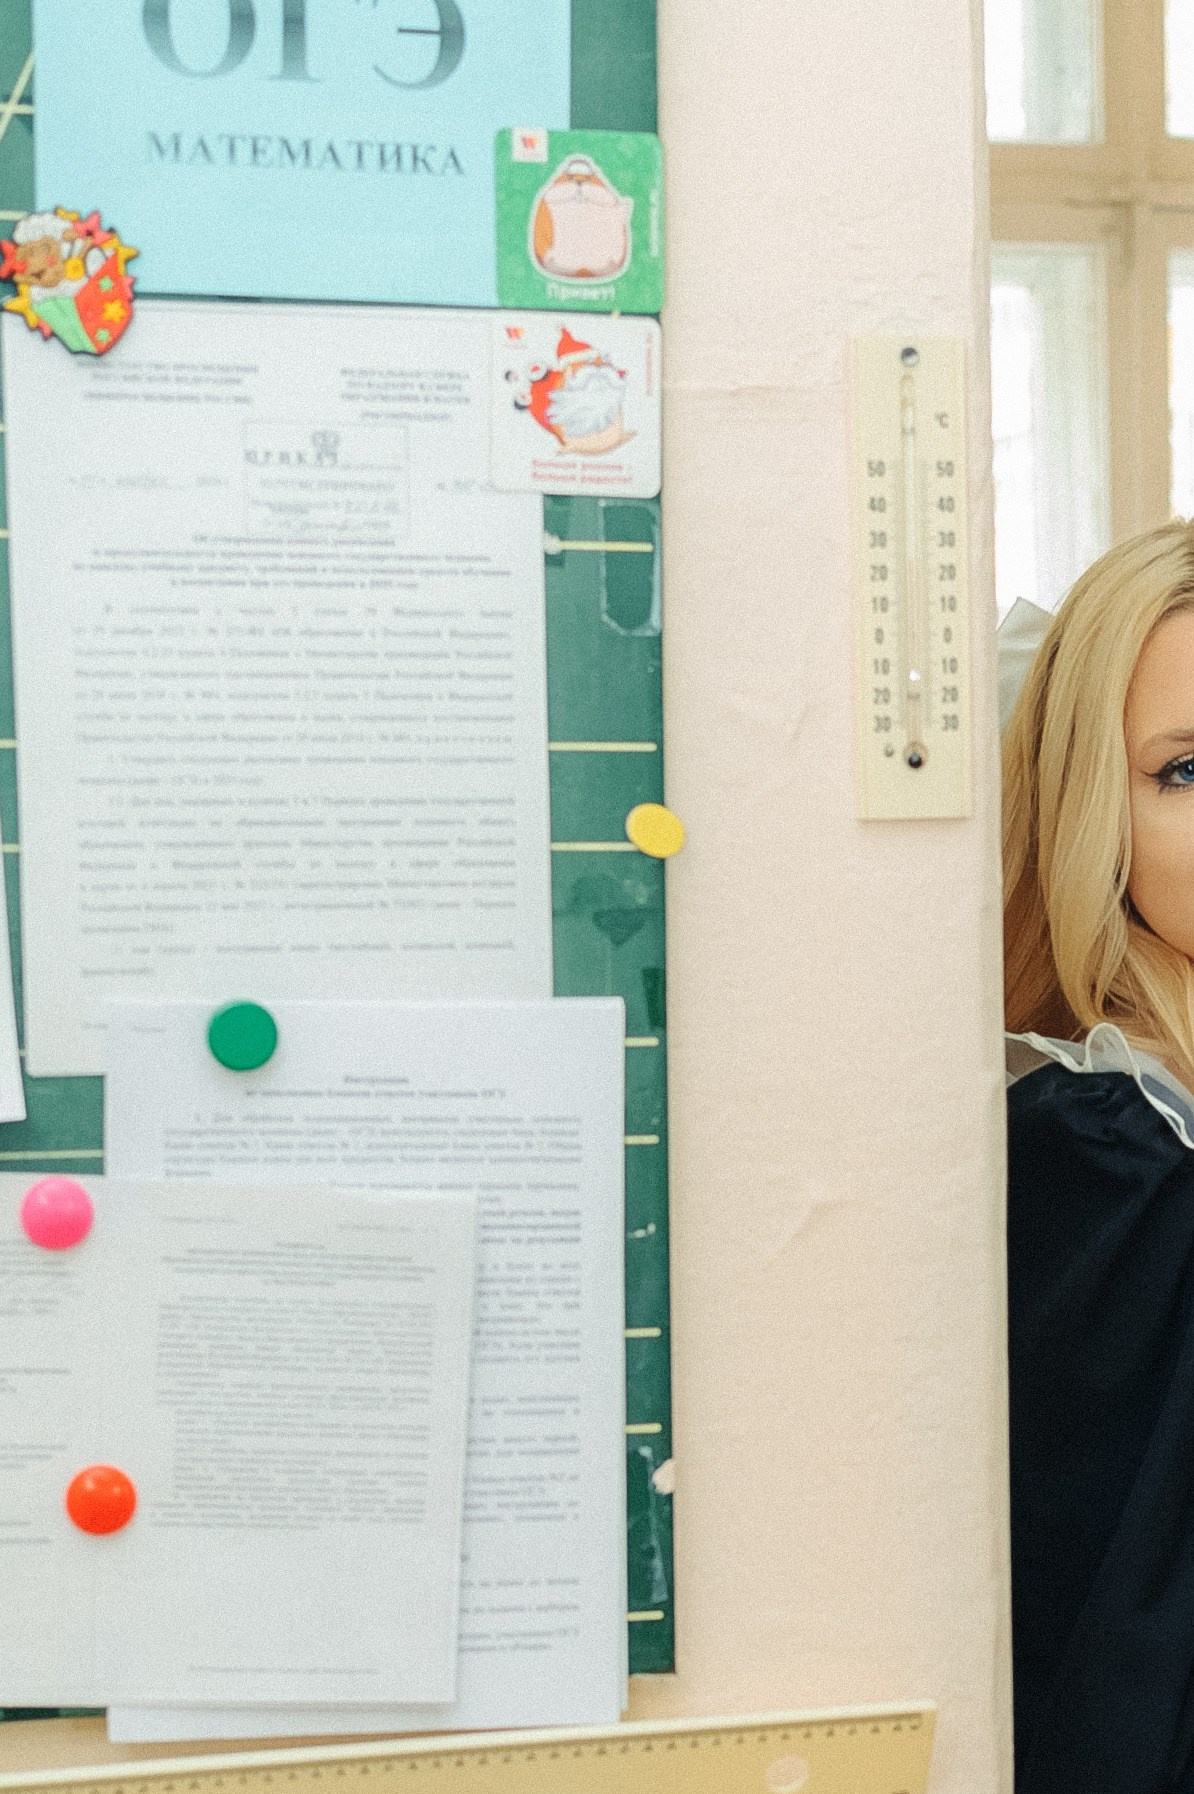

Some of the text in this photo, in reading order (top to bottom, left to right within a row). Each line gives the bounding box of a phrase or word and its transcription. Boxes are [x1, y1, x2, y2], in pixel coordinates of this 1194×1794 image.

[142, 0, 466, 90] ОГЭ
[147, 130, 467, 177] МАТЕМАТИКА
[868, 460, 886, 477] 50
[936, 460, 954, 477] 50
[869, 497, 887, 513] 40
[938, 497, 955, 513] 40
[870, 531, 888, 548] 30
[939, 531, 956, 548] 30
[871, 565, 888, 581] 20
[939, 564, 956, 581] 20
[872, 597, 889, 613] 10
[941, 596, 957, 612] 10
[875, 626, 885, 644] 0
[943, 626, 952, 643] 0
[874, 658, 890, 675] 10
[942, 657, 958, 673] 10
[874, 687, 891, 704] 20
[942, 686, 958, 702] 20
[874, 715, 891, 732] 30
[942, 714, 959, 731] 30
